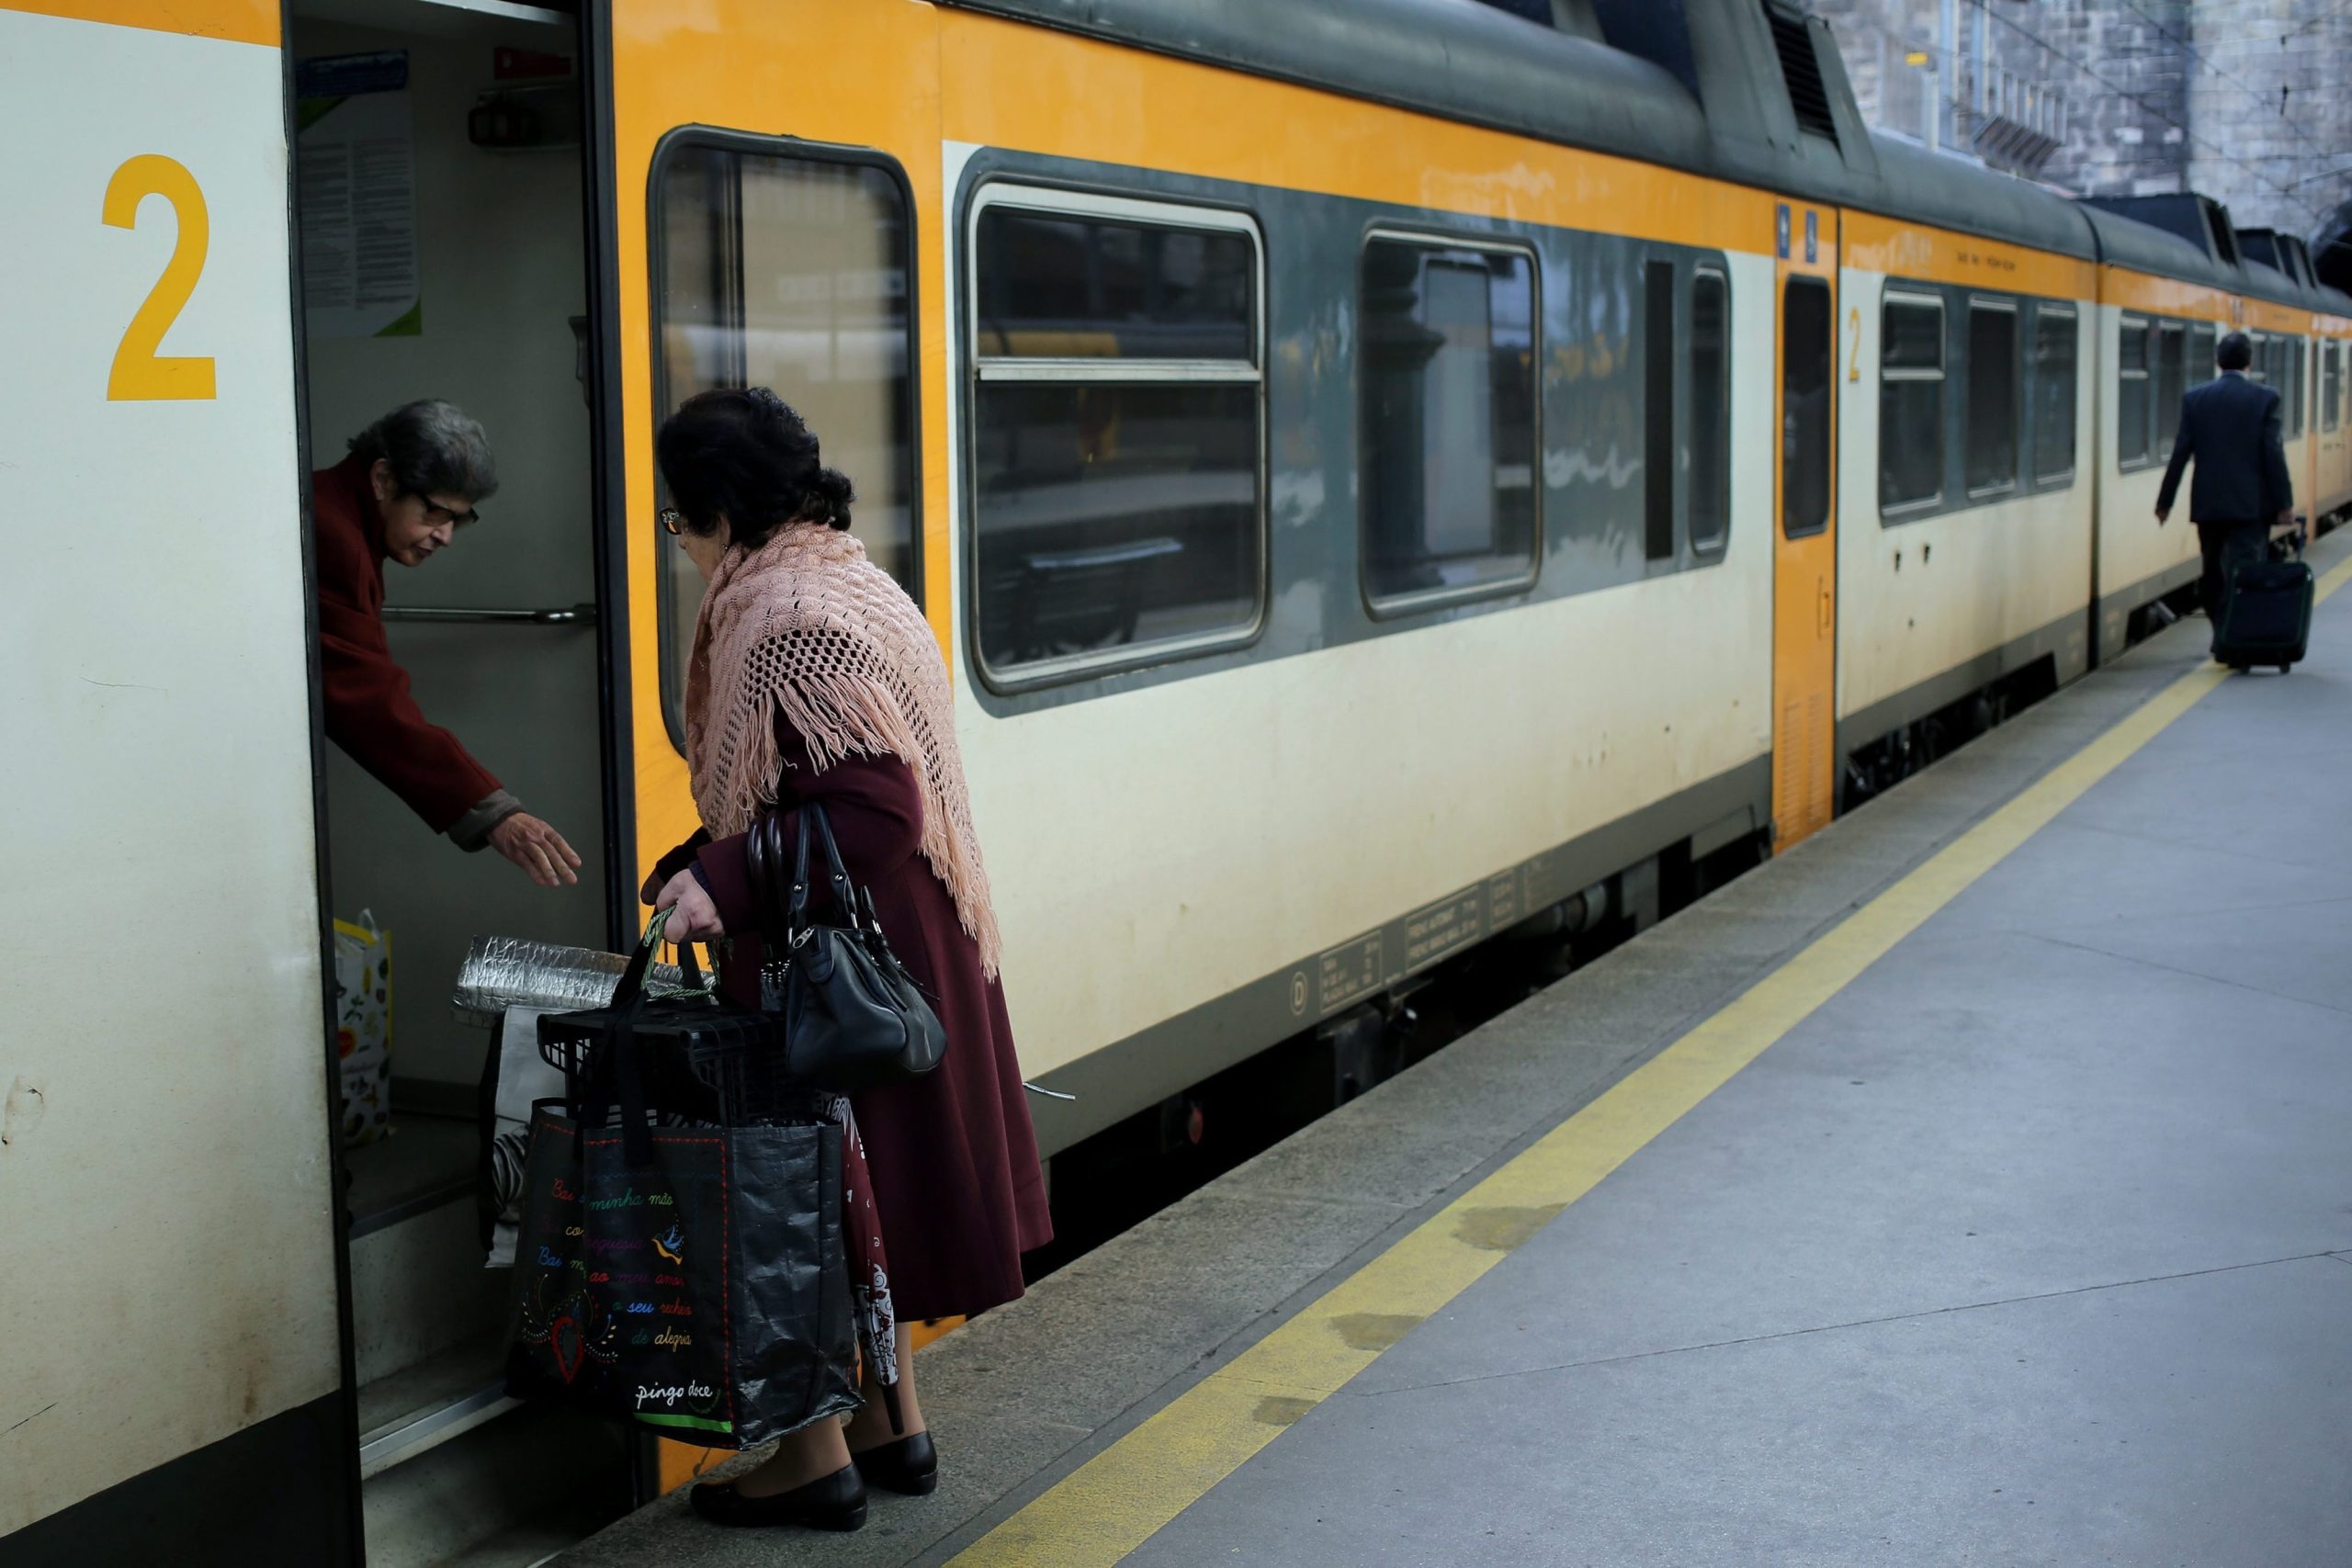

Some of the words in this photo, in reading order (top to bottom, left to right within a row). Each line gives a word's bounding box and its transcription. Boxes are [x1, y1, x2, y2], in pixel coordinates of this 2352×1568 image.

[102, 154, 217, 400] 2
[1849, 308, 1860, 382] 2
[1294, 982, 1305, 1007] D
[589, 1186, 644, 1211] minha
[538, 1244, 565, 1268] Bai
[589, 1271, 611, 1284] ao
[627, 1301, 654, 1314] seu
[632, 1327, 649, 1345] de
[654, 1325, 692, 1353] alegria
[636, 1381, 684, 1410] pingo
[687, 1379, 713, 1397] doce
